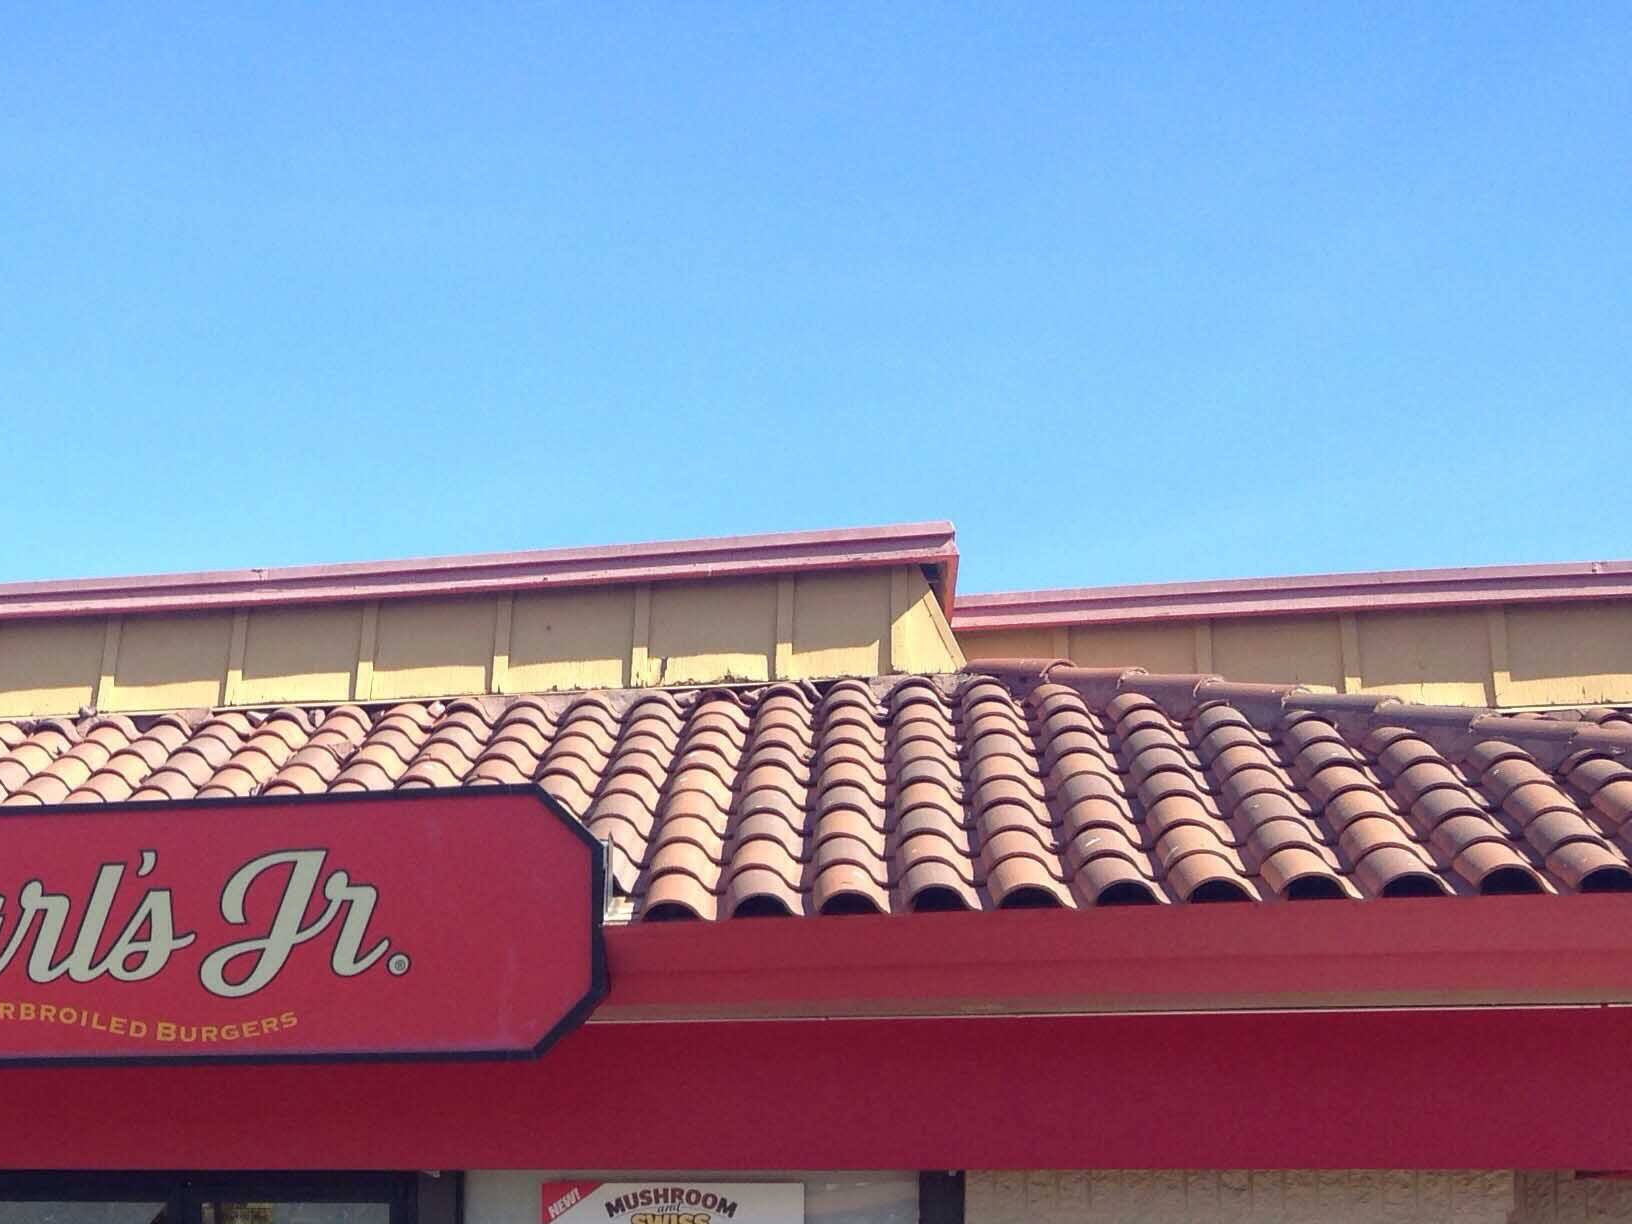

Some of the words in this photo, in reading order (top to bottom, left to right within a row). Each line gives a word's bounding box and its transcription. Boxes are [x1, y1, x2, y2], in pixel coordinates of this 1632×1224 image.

[198, 846, 412, 1000] Jr.
[155, 1008, 299, 1042] BURGERS
[547, 1187, 582, 1219] NEW!
[604, 1187, 738, 1218] MUSHROOM
[656, 1202, 682, 1213] and
